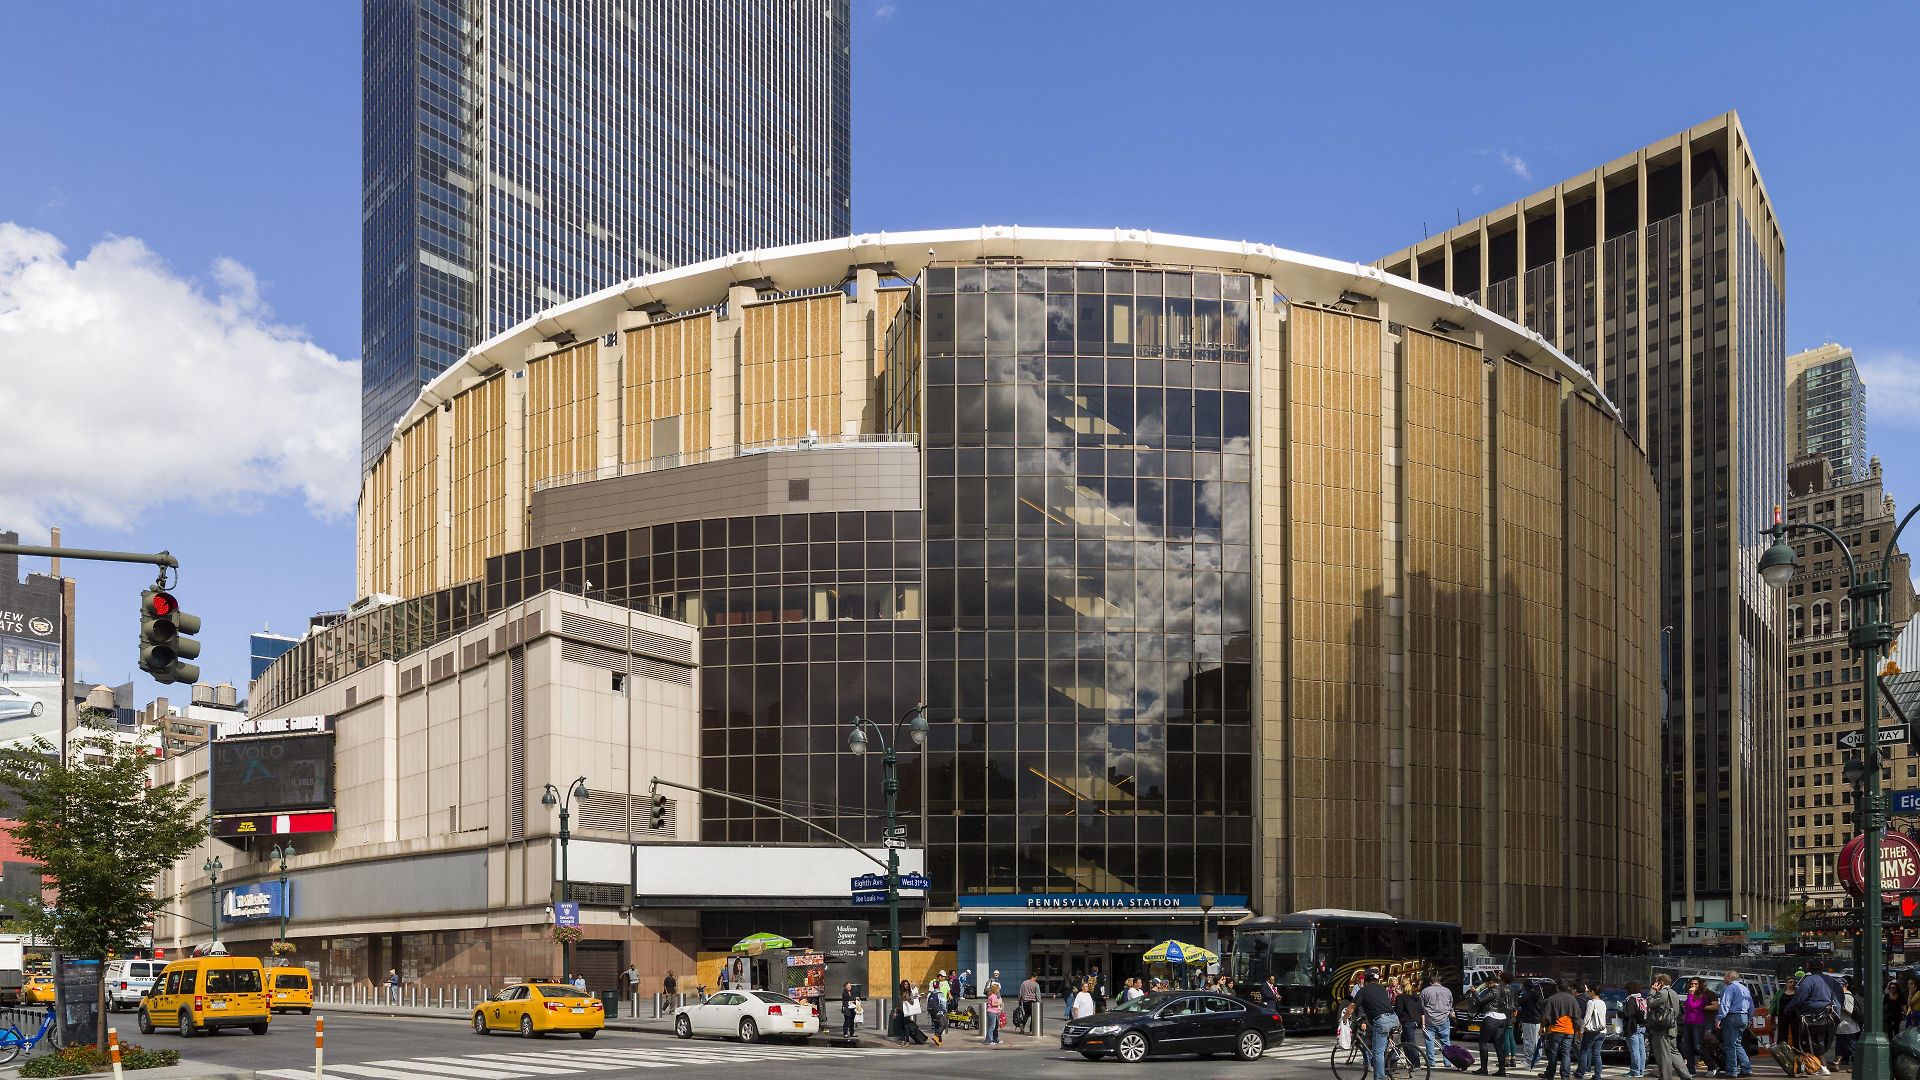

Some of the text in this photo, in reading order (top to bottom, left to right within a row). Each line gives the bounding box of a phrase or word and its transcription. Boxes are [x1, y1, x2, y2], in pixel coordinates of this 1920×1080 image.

[235, 744, 285, 761] VOLO
[854, 879, 872, 888] Eighth
[1027, 898, 1181, 907] PENNSYLVANIA STATION
[1831, 917, 1854, 927] RIBS
[837, 932, 856, 940] Square
